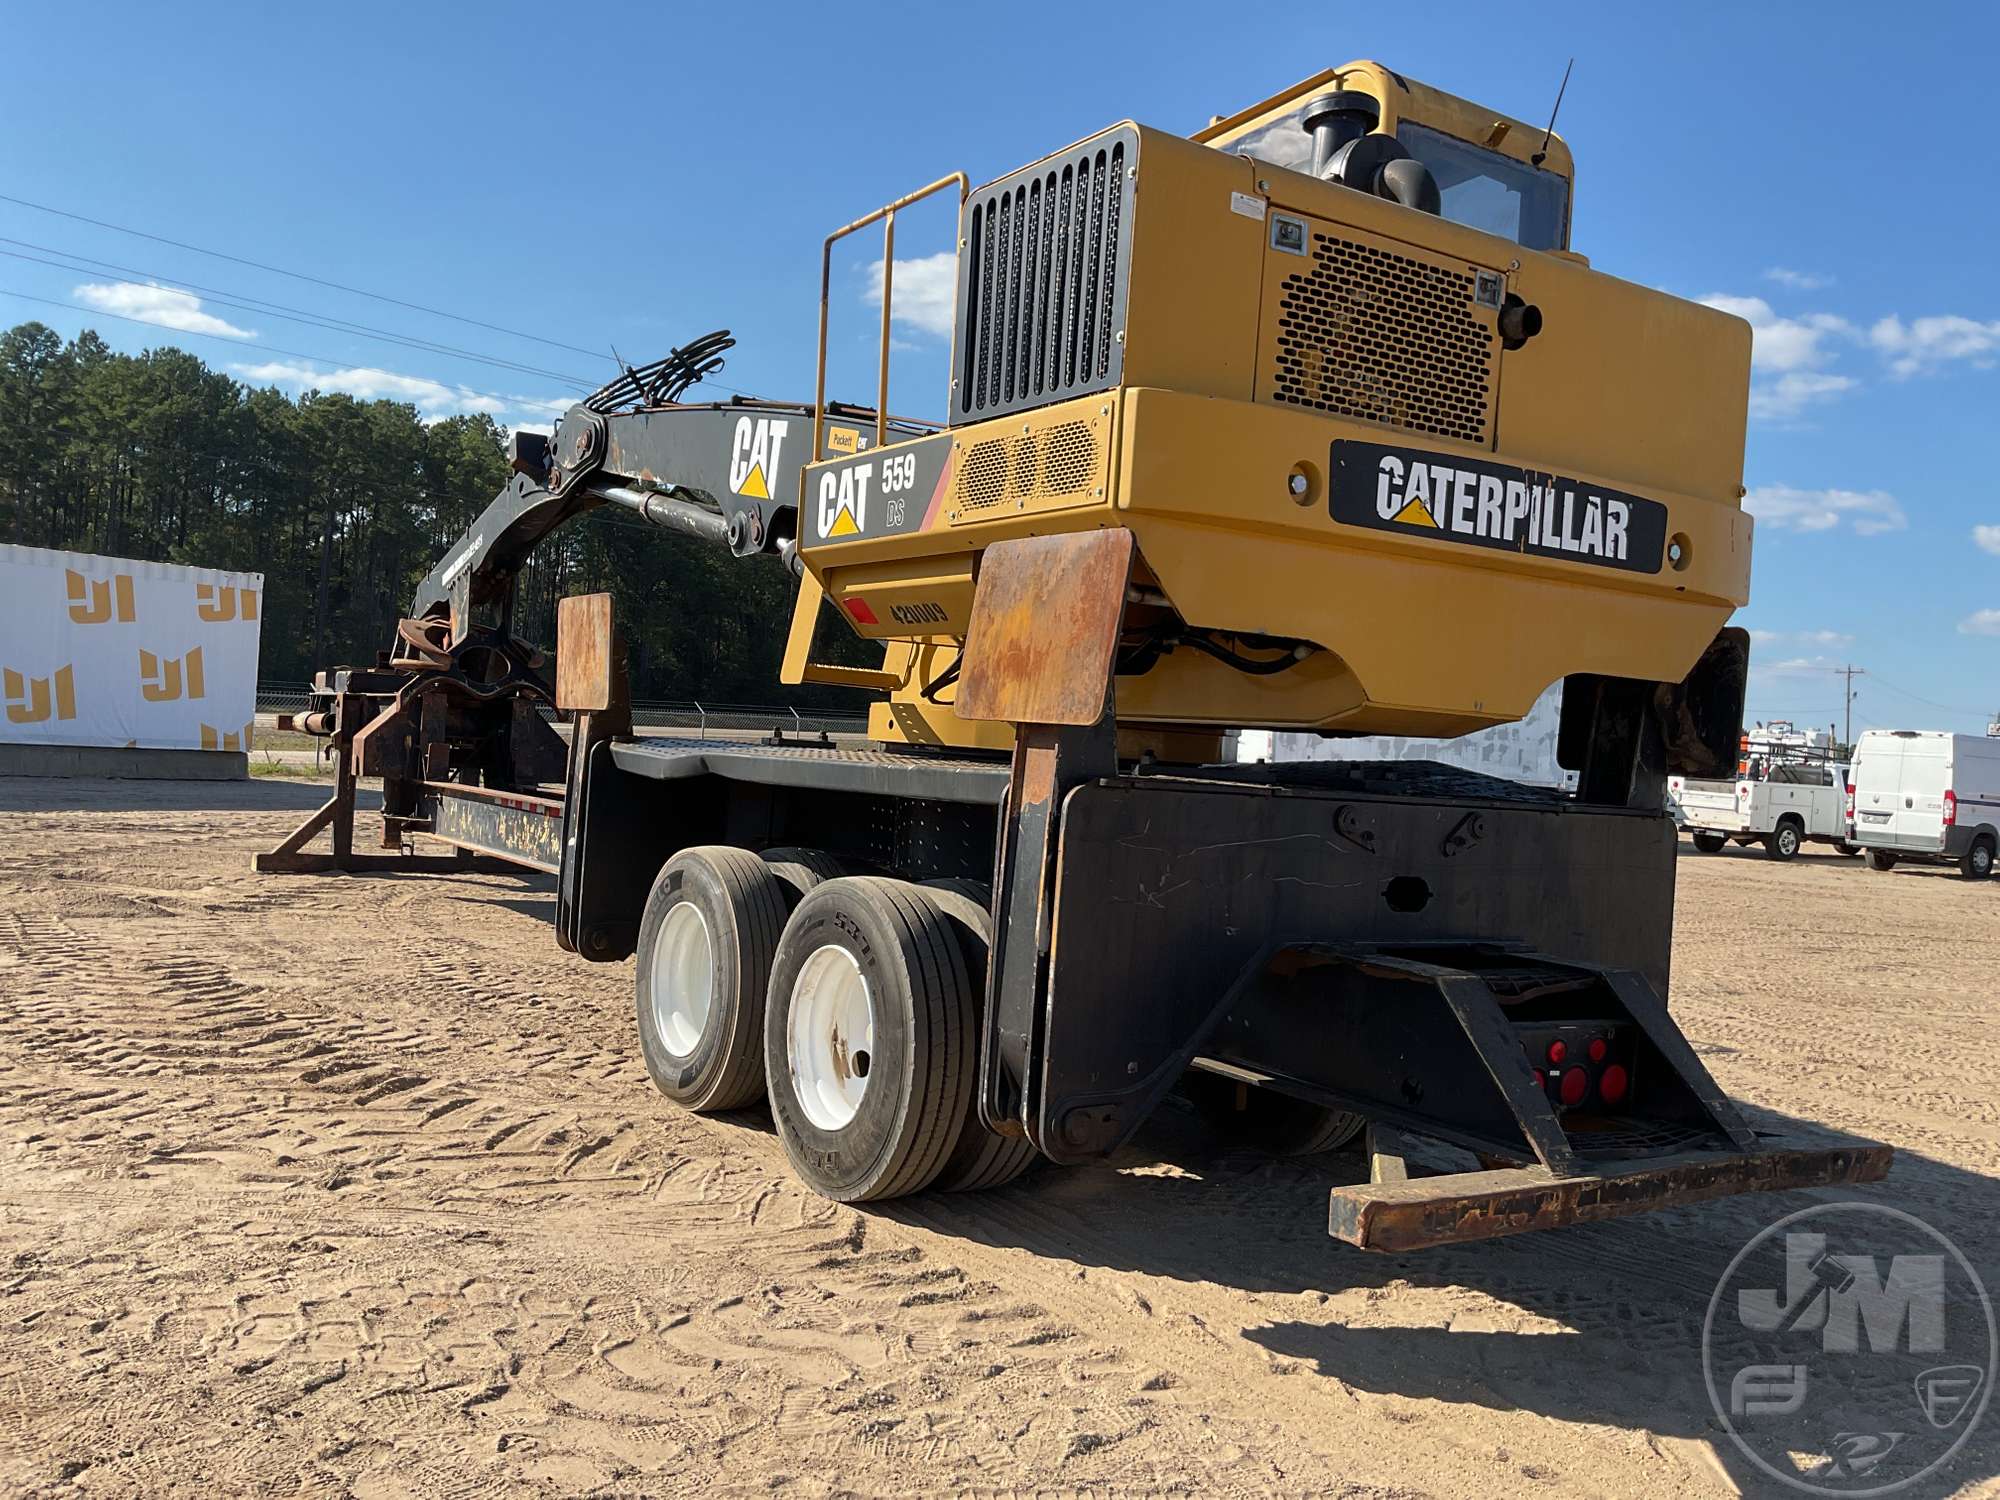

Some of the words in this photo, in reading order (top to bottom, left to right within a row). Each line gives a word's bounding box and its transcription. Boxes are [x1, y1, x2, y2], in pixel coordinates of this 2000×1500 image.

[729, 416, 788, 500] CAT
[817, 463, 873, 539] CAT
[881, 453, 916, 494] 559
[886, 498, 905, 528] DS
[1376, 455, 1631, 560] CATERPILLAR
[889, 602, 949, 625] 420009
